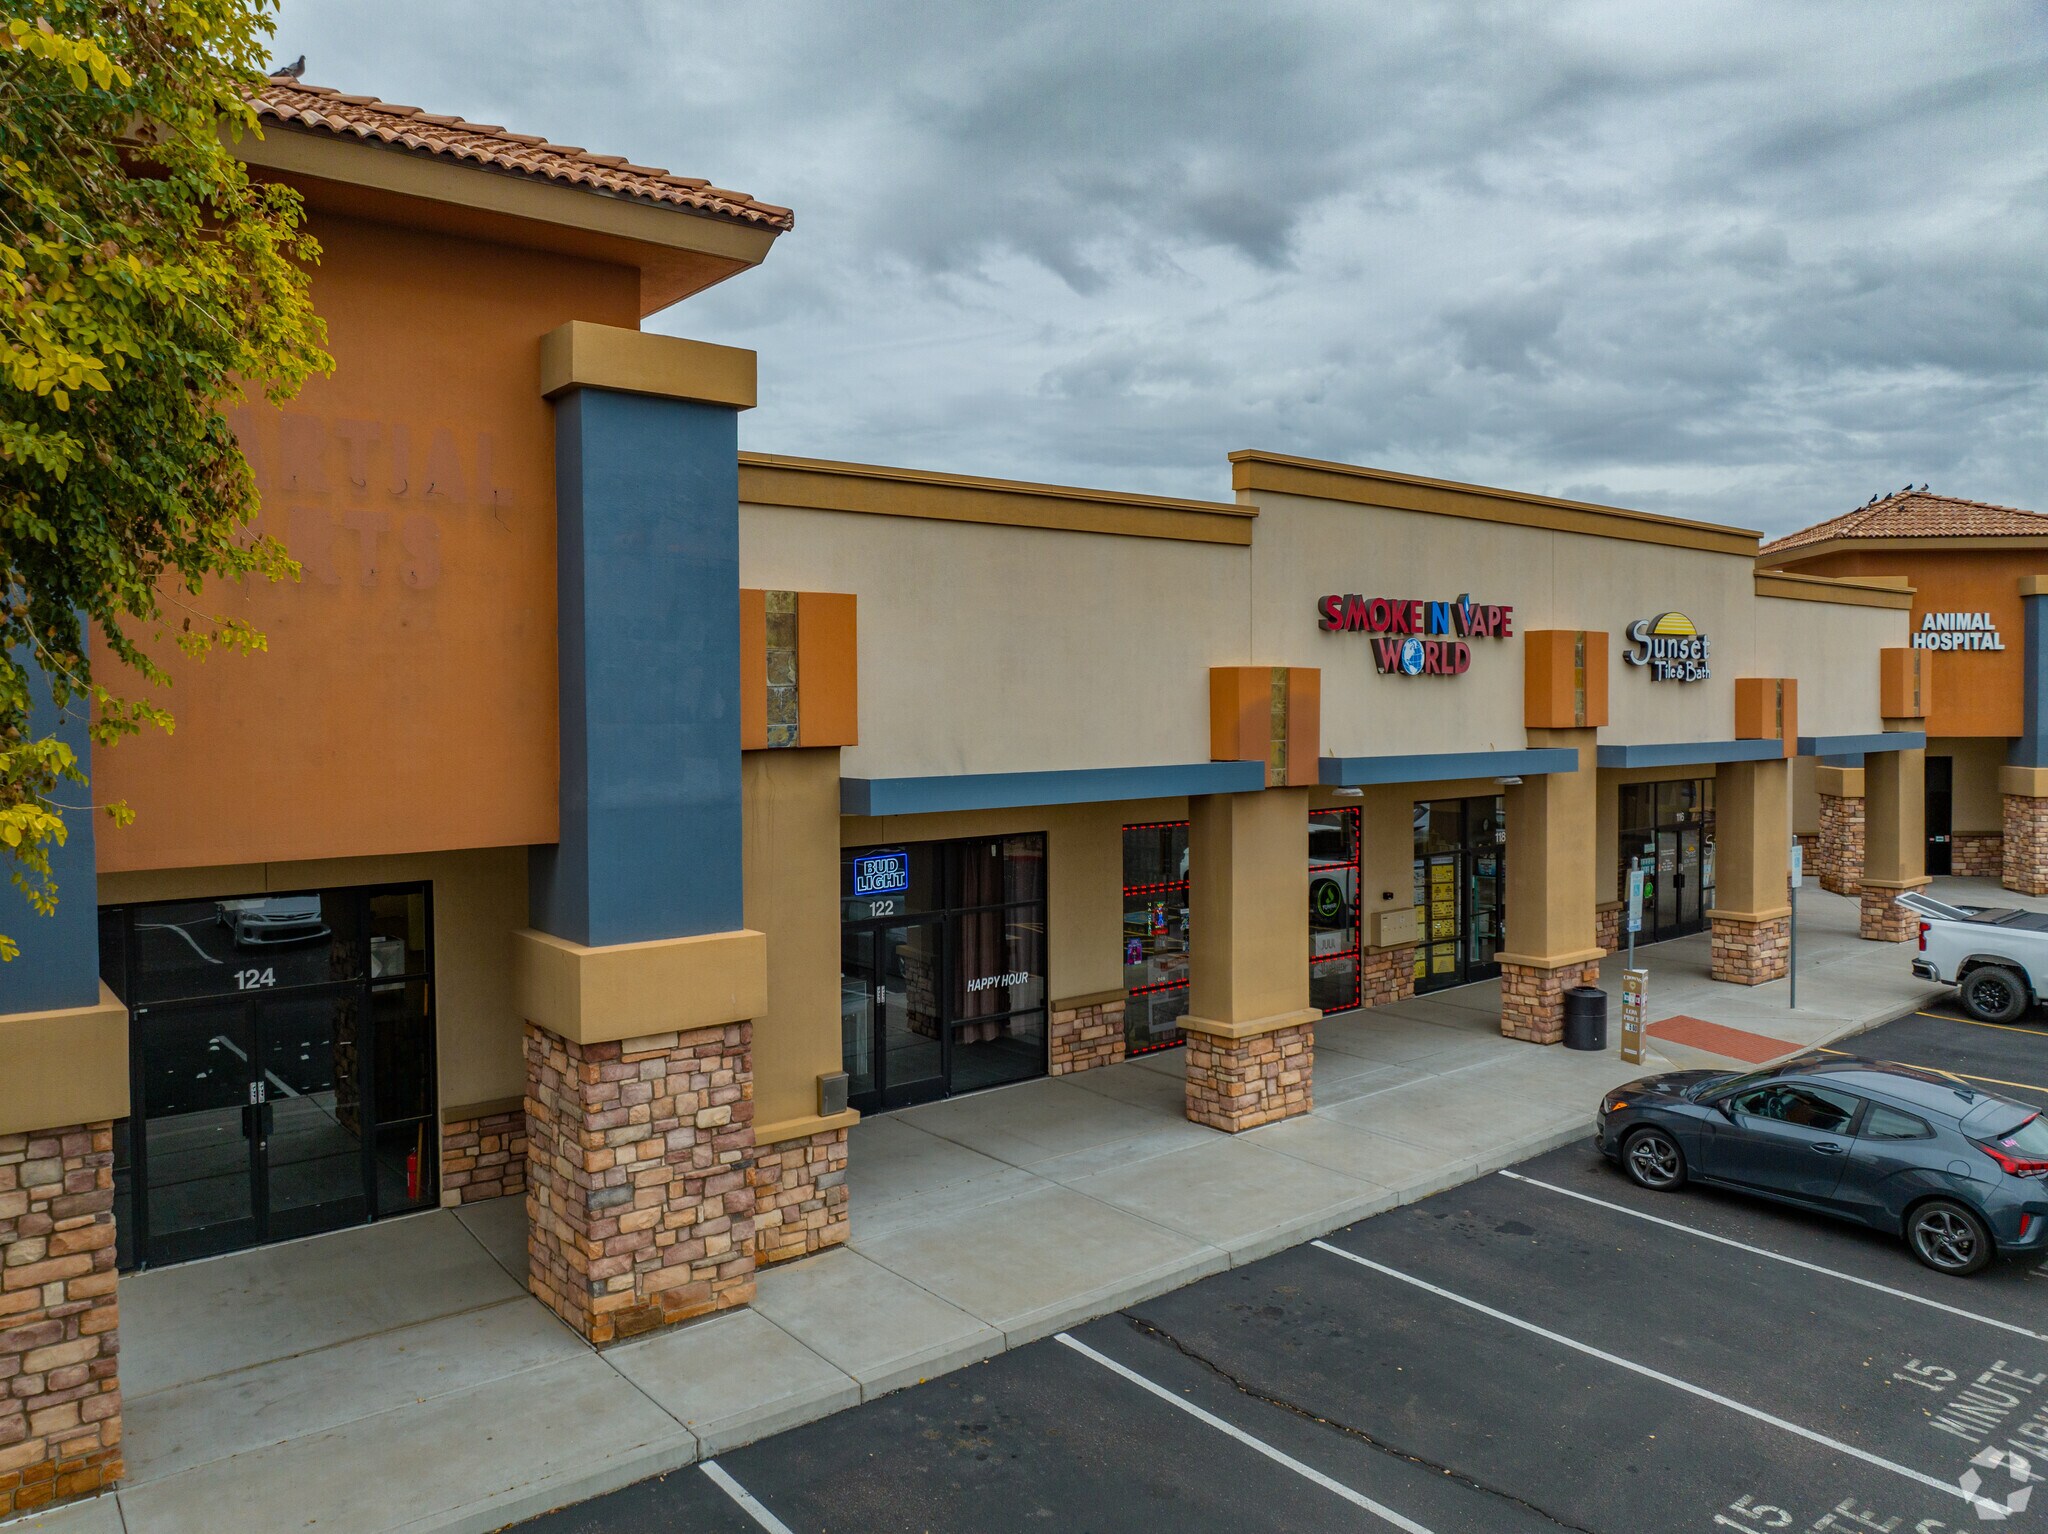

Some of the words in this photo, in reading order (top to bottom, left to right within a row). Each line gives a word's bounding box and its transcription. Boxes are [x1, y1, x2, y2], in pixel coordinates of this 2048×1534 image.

[1318, 594, 1424, 634] SMOKE
[1425, 601, 1450, 635] N
[1451, 593, 1513, 637] VAPE
[1922, 612, 1996, 632] ANIMAL
[1623, 619, 1711, 667] Sunset
[1913, 631, 2006, 651] HOSPITAL
[1370, 637, 1471, 675] WORLD
[1652, 660, 1676, 681] Tile
[1685, 660, 1712, 682] Bath
[1495, 831, 1507, 843] 118
[863, 858, 899, 875] BUD
[856, 871, 906, 892] LIGHT
[869, 900, 894, 917] 122
[234, 967, 276, 990] 124
[966, 974, 1000, 993] HAPPY
[1001, 971, 1029, 988] HOUR
[1892, 1358, 1957, 1392] 15
[1928, 1359, 2048, 1444] MINUTE
